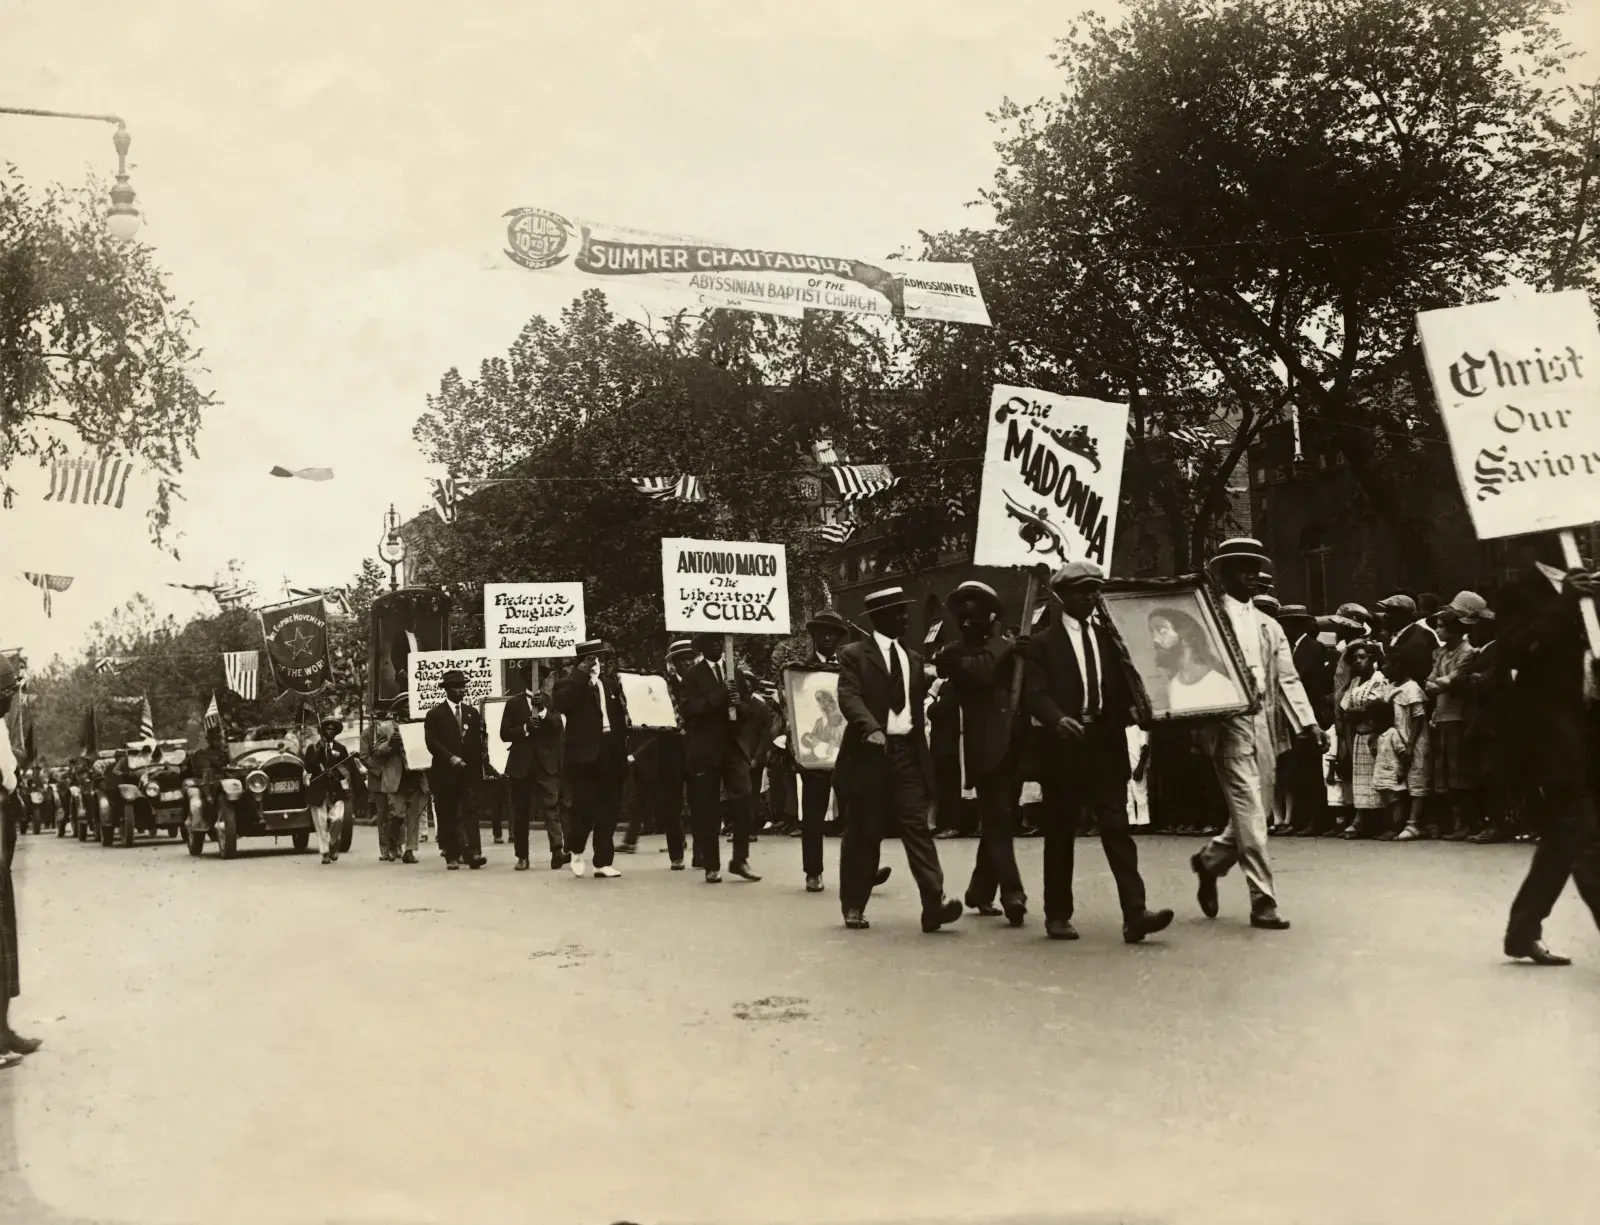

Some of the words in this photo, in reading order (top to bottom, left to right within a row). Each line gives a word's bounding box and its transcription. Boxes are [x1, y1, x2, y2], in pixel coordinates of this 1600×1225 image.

[543, 236, 561, 254] 17
[590, 245, 689, 270] SUMMER
[697, 250, 854, 277] CHAUTAUQUA
[689, 273, 765, 298] ABYSSINIAN
[768, 284, 821, 305] BAPTIST
[824, 291, 877, 312] CHURCH
[808, 278, 823, 289] OF
[825, 280, 845, 292] THE
[904, 279, 953, 293] ADMISSION
[954, 284, 977, 298] FREE
[1449, 346, 1584, 398] Christ
[1006, 396, 1052, 419] The
[1494, 404, 1572, 433] Our
[1003, 419, 1108, 566] MADONNA
[677, 550, 734, 574] ANTONIO
[735, 553, 777, 577] MACEO
[709, 577, 739, 588] The
[495, 592, 569, 606] Frederick
[680, 587, 777, 606] Liberator!
[505, 604, 575, 622] Douglas!
[682, 601, 698, 618] of
[702, 602, 775, 621] CUBA
[292, 613, 325, 629] MOVEMENT
[498, 623, 561, 636] Emancipator
[499, 637, 545, 649] American
[545, 635, 575, 649] Negro
[276, 663, 287, 673] OF
[287, 667, 303, 678] THE
[416, 659, 473, 671] Booker
